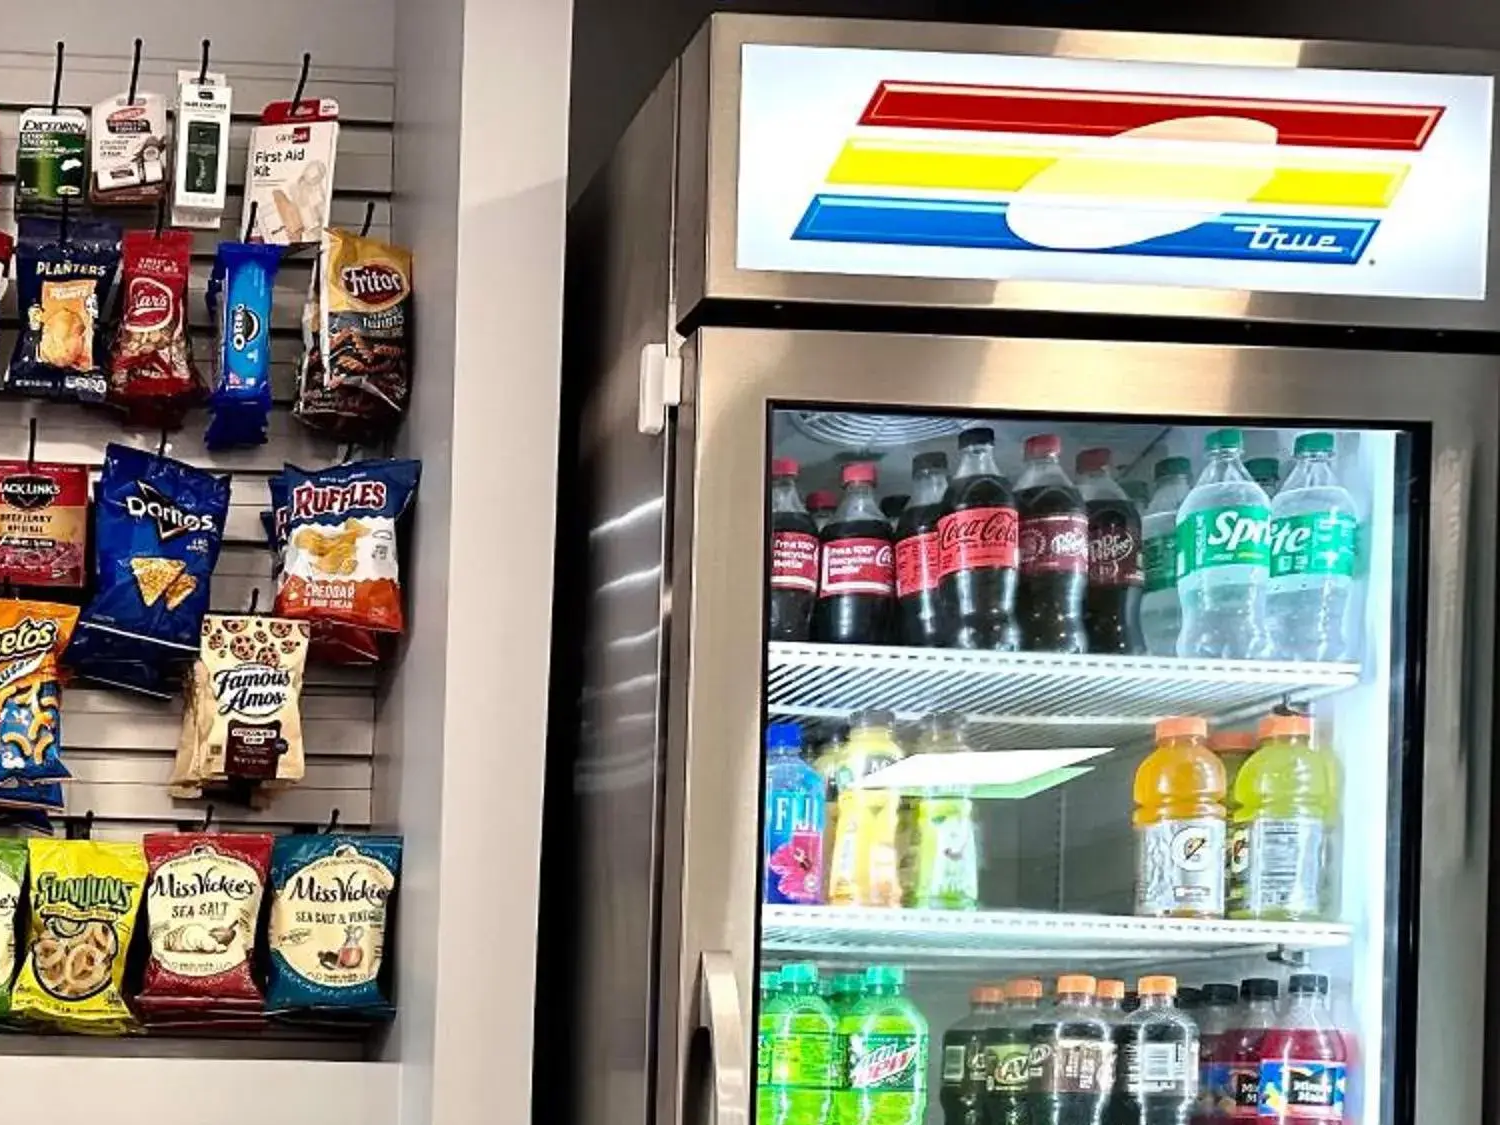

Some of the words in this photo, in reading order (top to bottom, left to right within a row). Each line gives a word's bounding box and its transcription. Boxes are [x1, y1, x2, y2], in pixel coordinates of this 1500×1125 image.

[253, 164, 271, 177] Kit
[255, 151, 282, 164] First
[284, 149, 305, 161] Aid
[36, 261, 107, 276] PLANTERS
[232, 303, 245, 350] OREO
[125, 495, 213, 532] Doritos
[291, 481, 386, 518] RUFFLES
[1208, 510, 1271, 551] Spri
[214, 668, 290, 700] Famous
[219, 689, 284, 716] Amos
[153, 873, 197, 896] Miss
[193, 869, 256, 898] Vickie's
[289, 876, 337, 902] Miss
[172, 903, 195, 918] SEA
[198, 901, 228, 916] SALT
